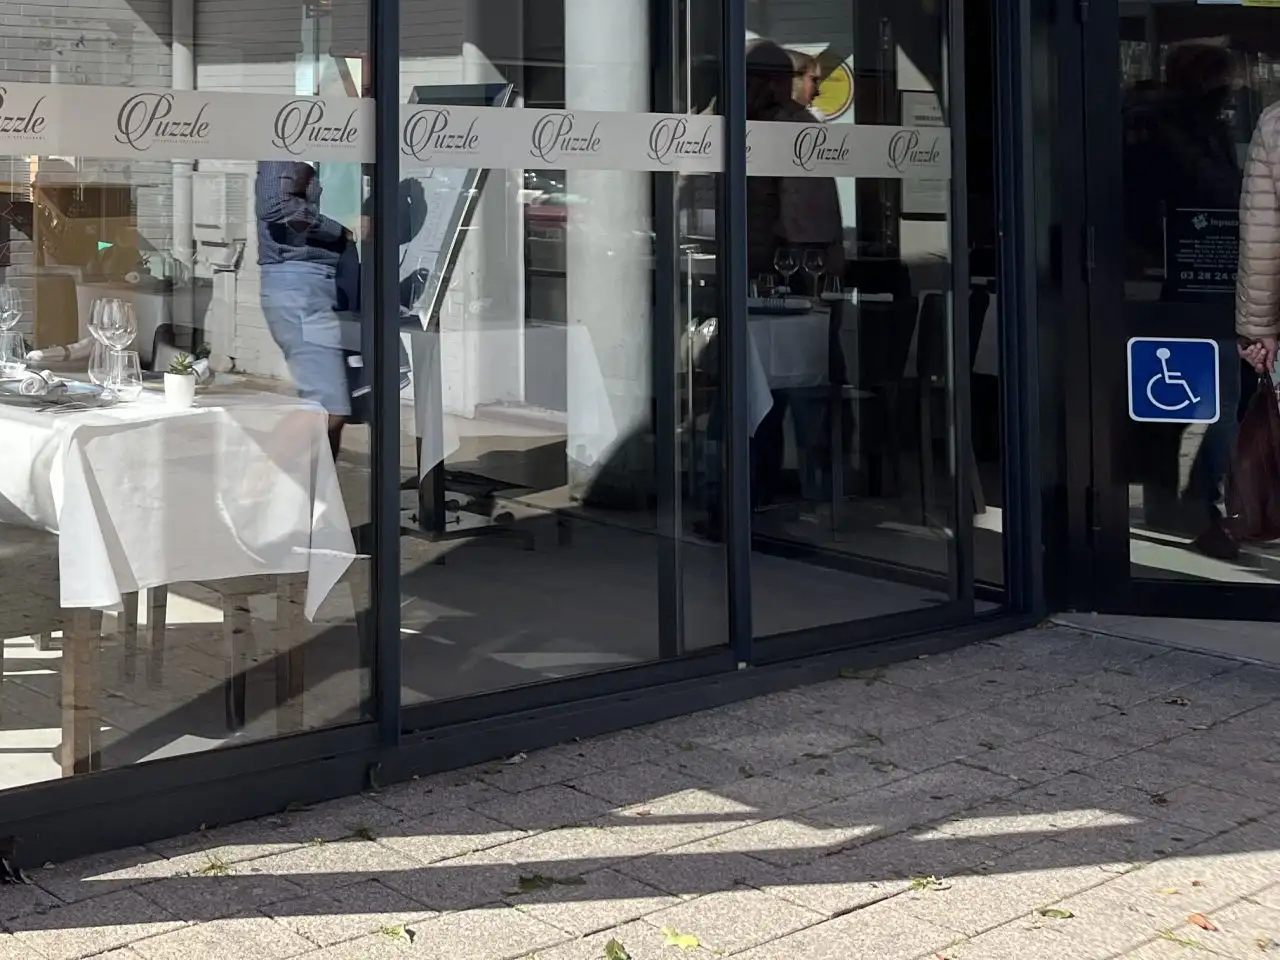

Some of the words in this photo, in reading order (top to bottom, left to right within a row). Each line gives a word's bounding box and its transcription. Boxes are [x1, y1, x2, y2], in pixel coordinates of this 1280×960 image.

[114, 93, 210, 151] Puzzle
[272, 99, 359, 155] Puzzle
[401, 109, 480, 162] Puzzle
[530, 113, 602, 163] Puzzle
[647, 117, 712, 165] Puzzle
[792, 126, 849, 172] Puzzle
[887, 129, 941, 173] Puzzle
